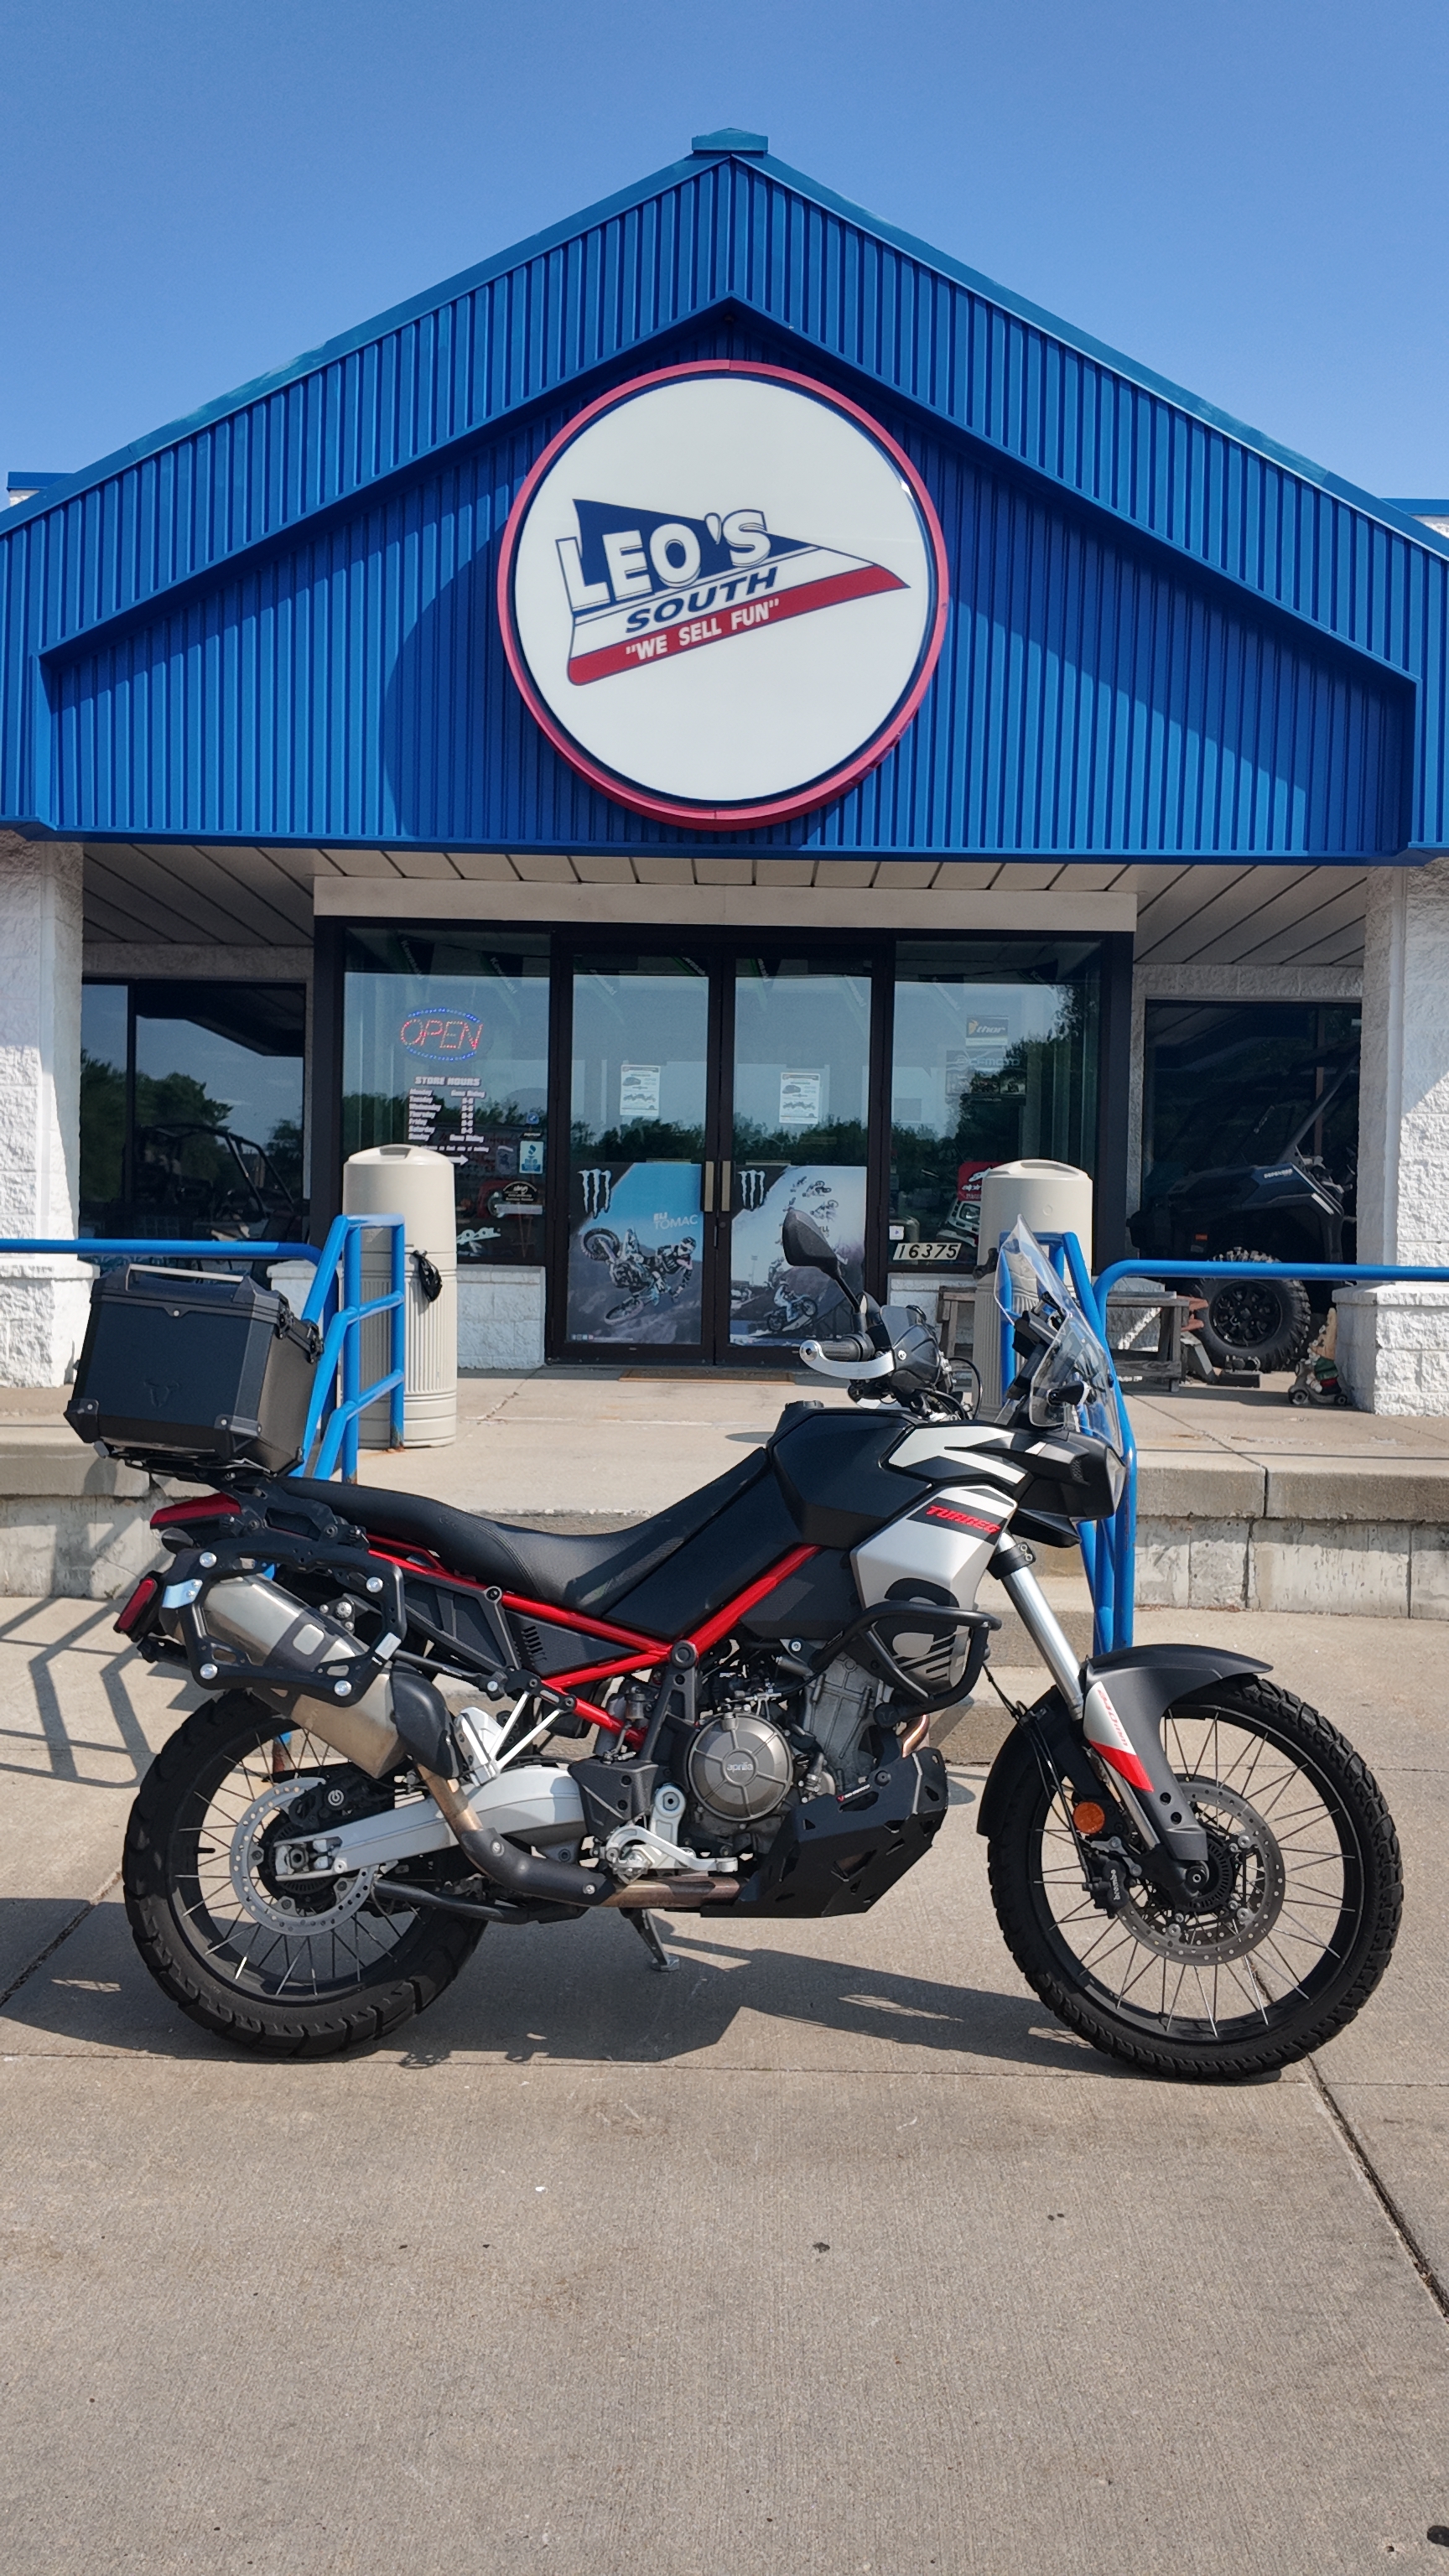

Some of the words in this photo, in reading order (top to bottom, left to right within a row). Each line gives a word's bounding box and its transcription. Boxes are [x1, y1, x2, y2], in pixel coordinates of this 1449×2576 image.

[555, 508, 771, 611] LEO'S
[626, 566, 778, 633] SOUTH
[626, 634, 667, 660] "WE
[678, 617, 722, 646] SELL
[730, 598, 780, 631] FUN"
[400, 1018, 484, 1050] OPEN
[976, 1025, 1006, 1034] thor
[414, 1076, 445, 1086] STORE
[447, 1077, 481, 1087] HOURS
[653, 1212, 668, 1221] ELI
[654, 1213, 699, 1230] TOMAC
[898, 1244, 959, 1259] 16375
[1110, 1868, 1121, 1900] brembo
